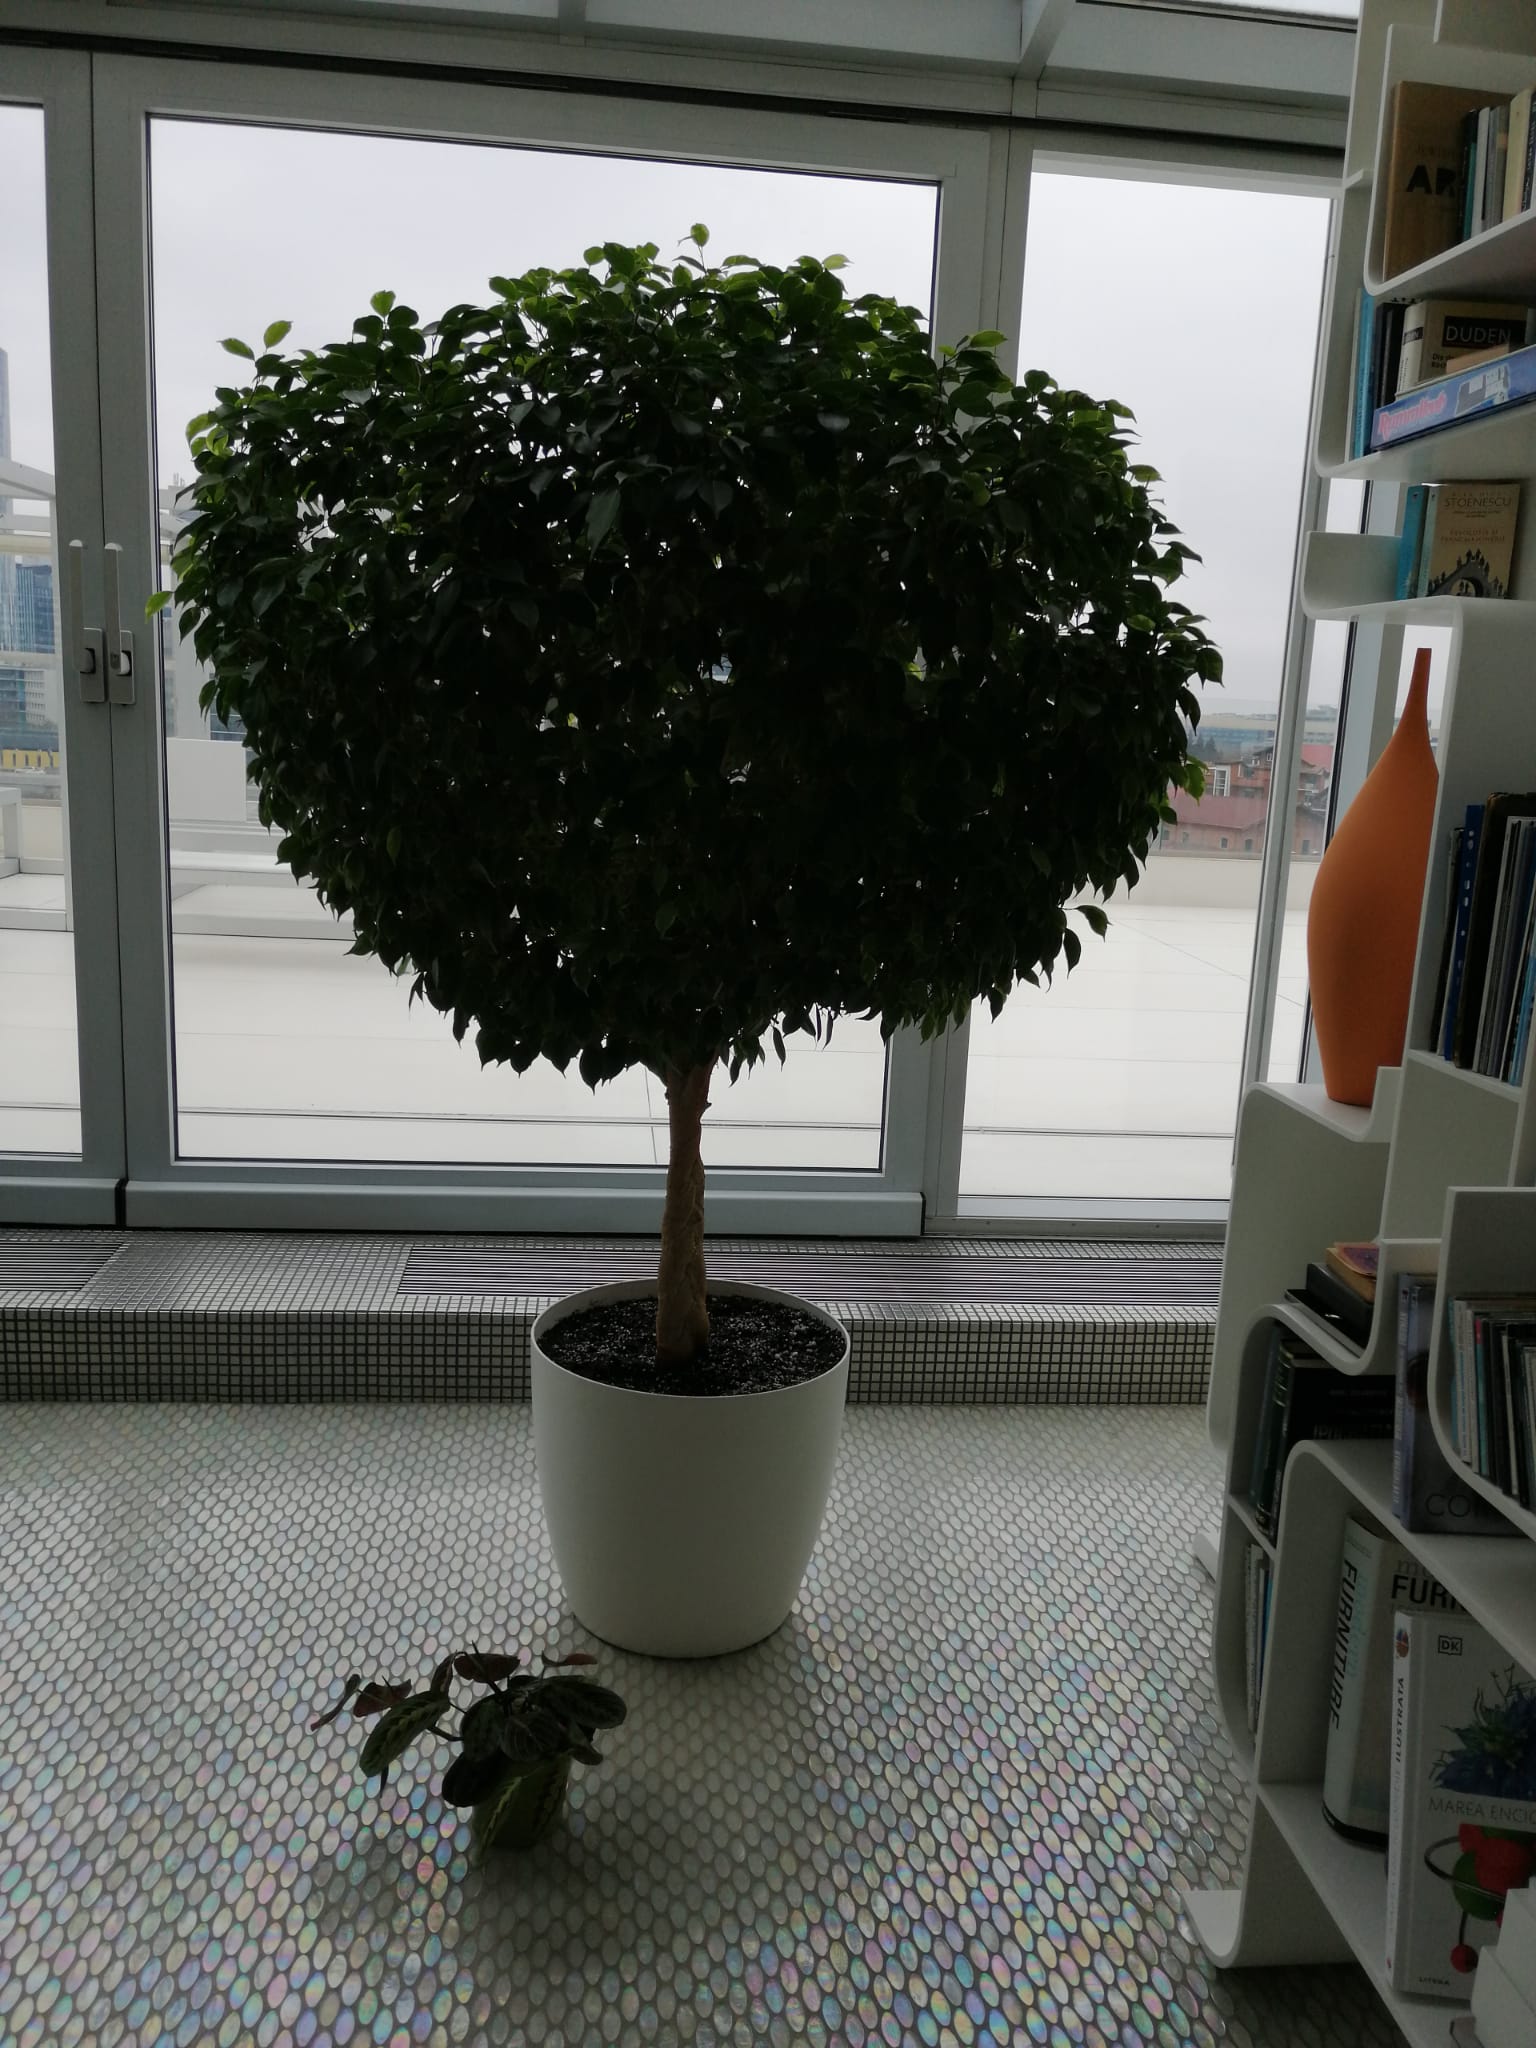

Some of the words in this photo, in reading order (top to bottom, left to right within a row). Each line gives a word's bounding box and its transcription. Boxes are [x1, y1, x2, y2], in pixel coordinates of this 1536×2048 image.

[1445, 325, 1512, 346] DUDEN
[1444, 496, 1512, 508] STOENESCU
[1330, 1559, 1358, 1730] FURNITURE
[1441, 1638, 1460, 1652] DK
[1428, 1797, 1485, 1818] MAREA
